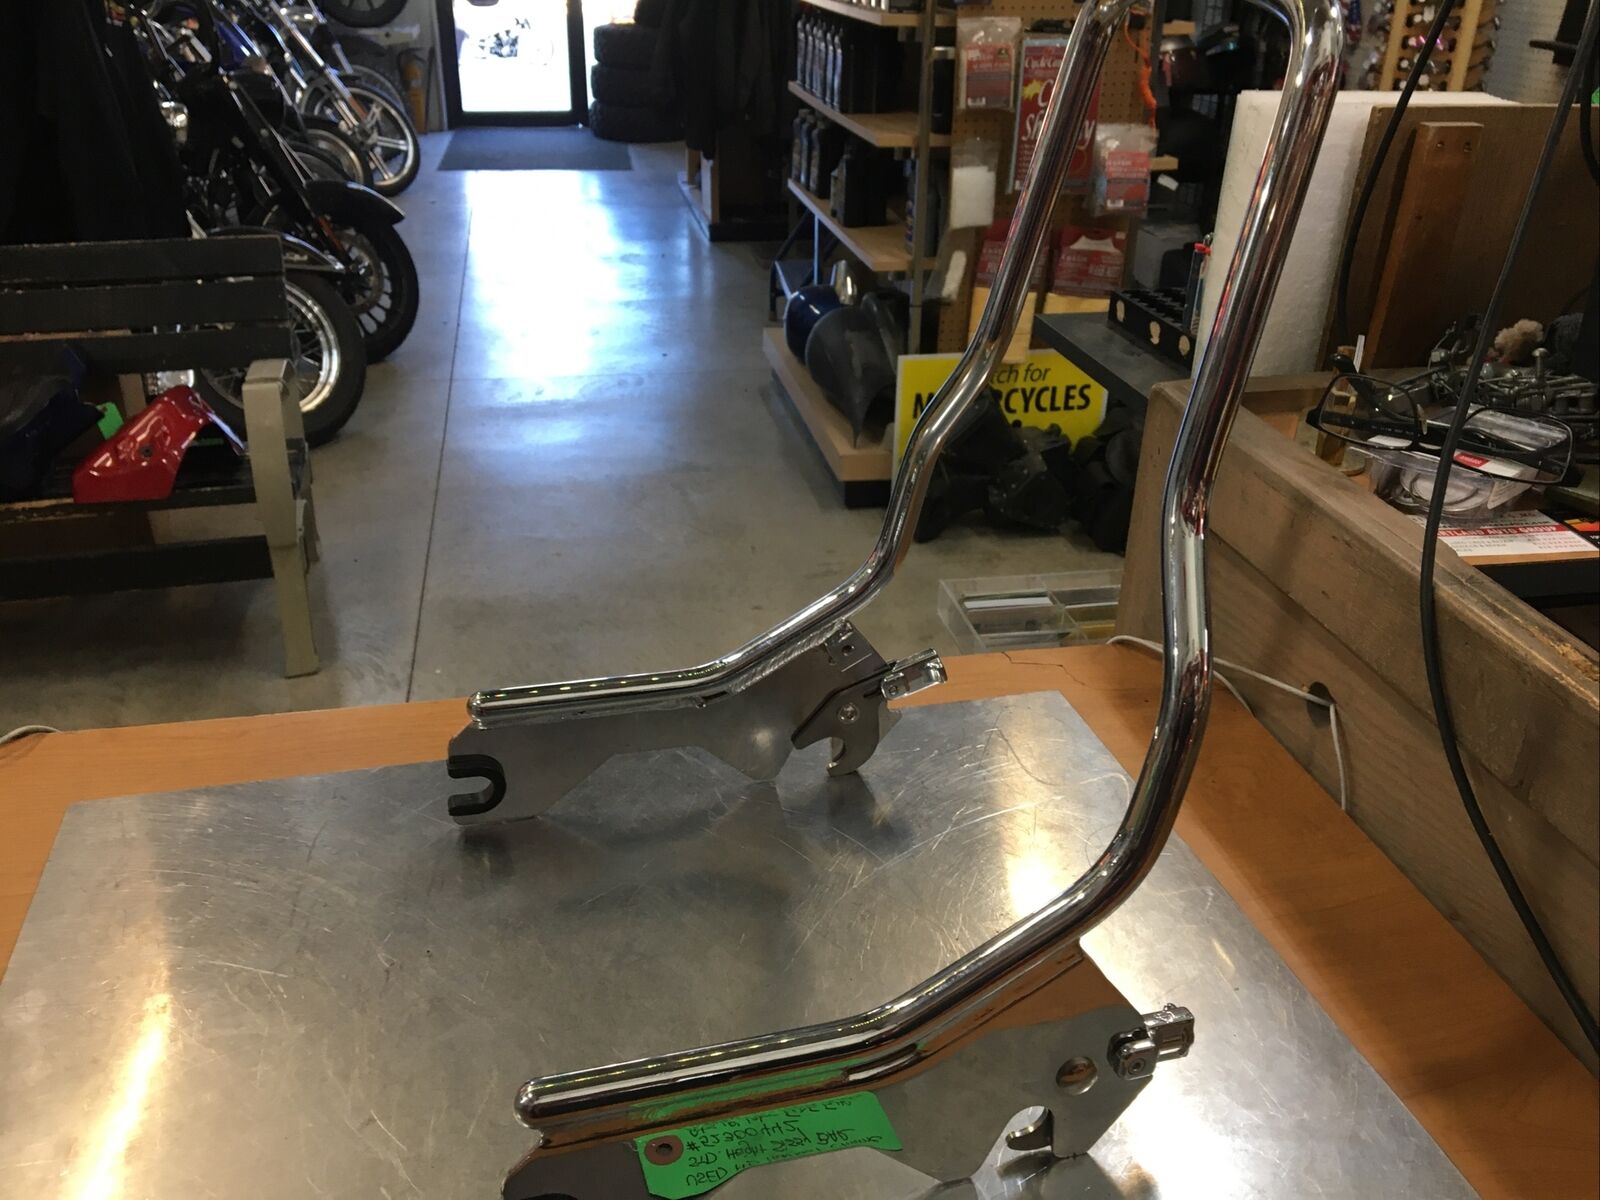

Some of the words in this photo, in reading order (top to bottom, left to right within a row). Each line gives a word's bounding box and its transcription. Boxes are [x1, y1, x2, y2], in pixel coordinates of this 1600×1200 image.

[990, 365, 1019, 384] tch
[1024, 362, 1052, 382] for
[912, 384, 1092, 419] MCYCLES
